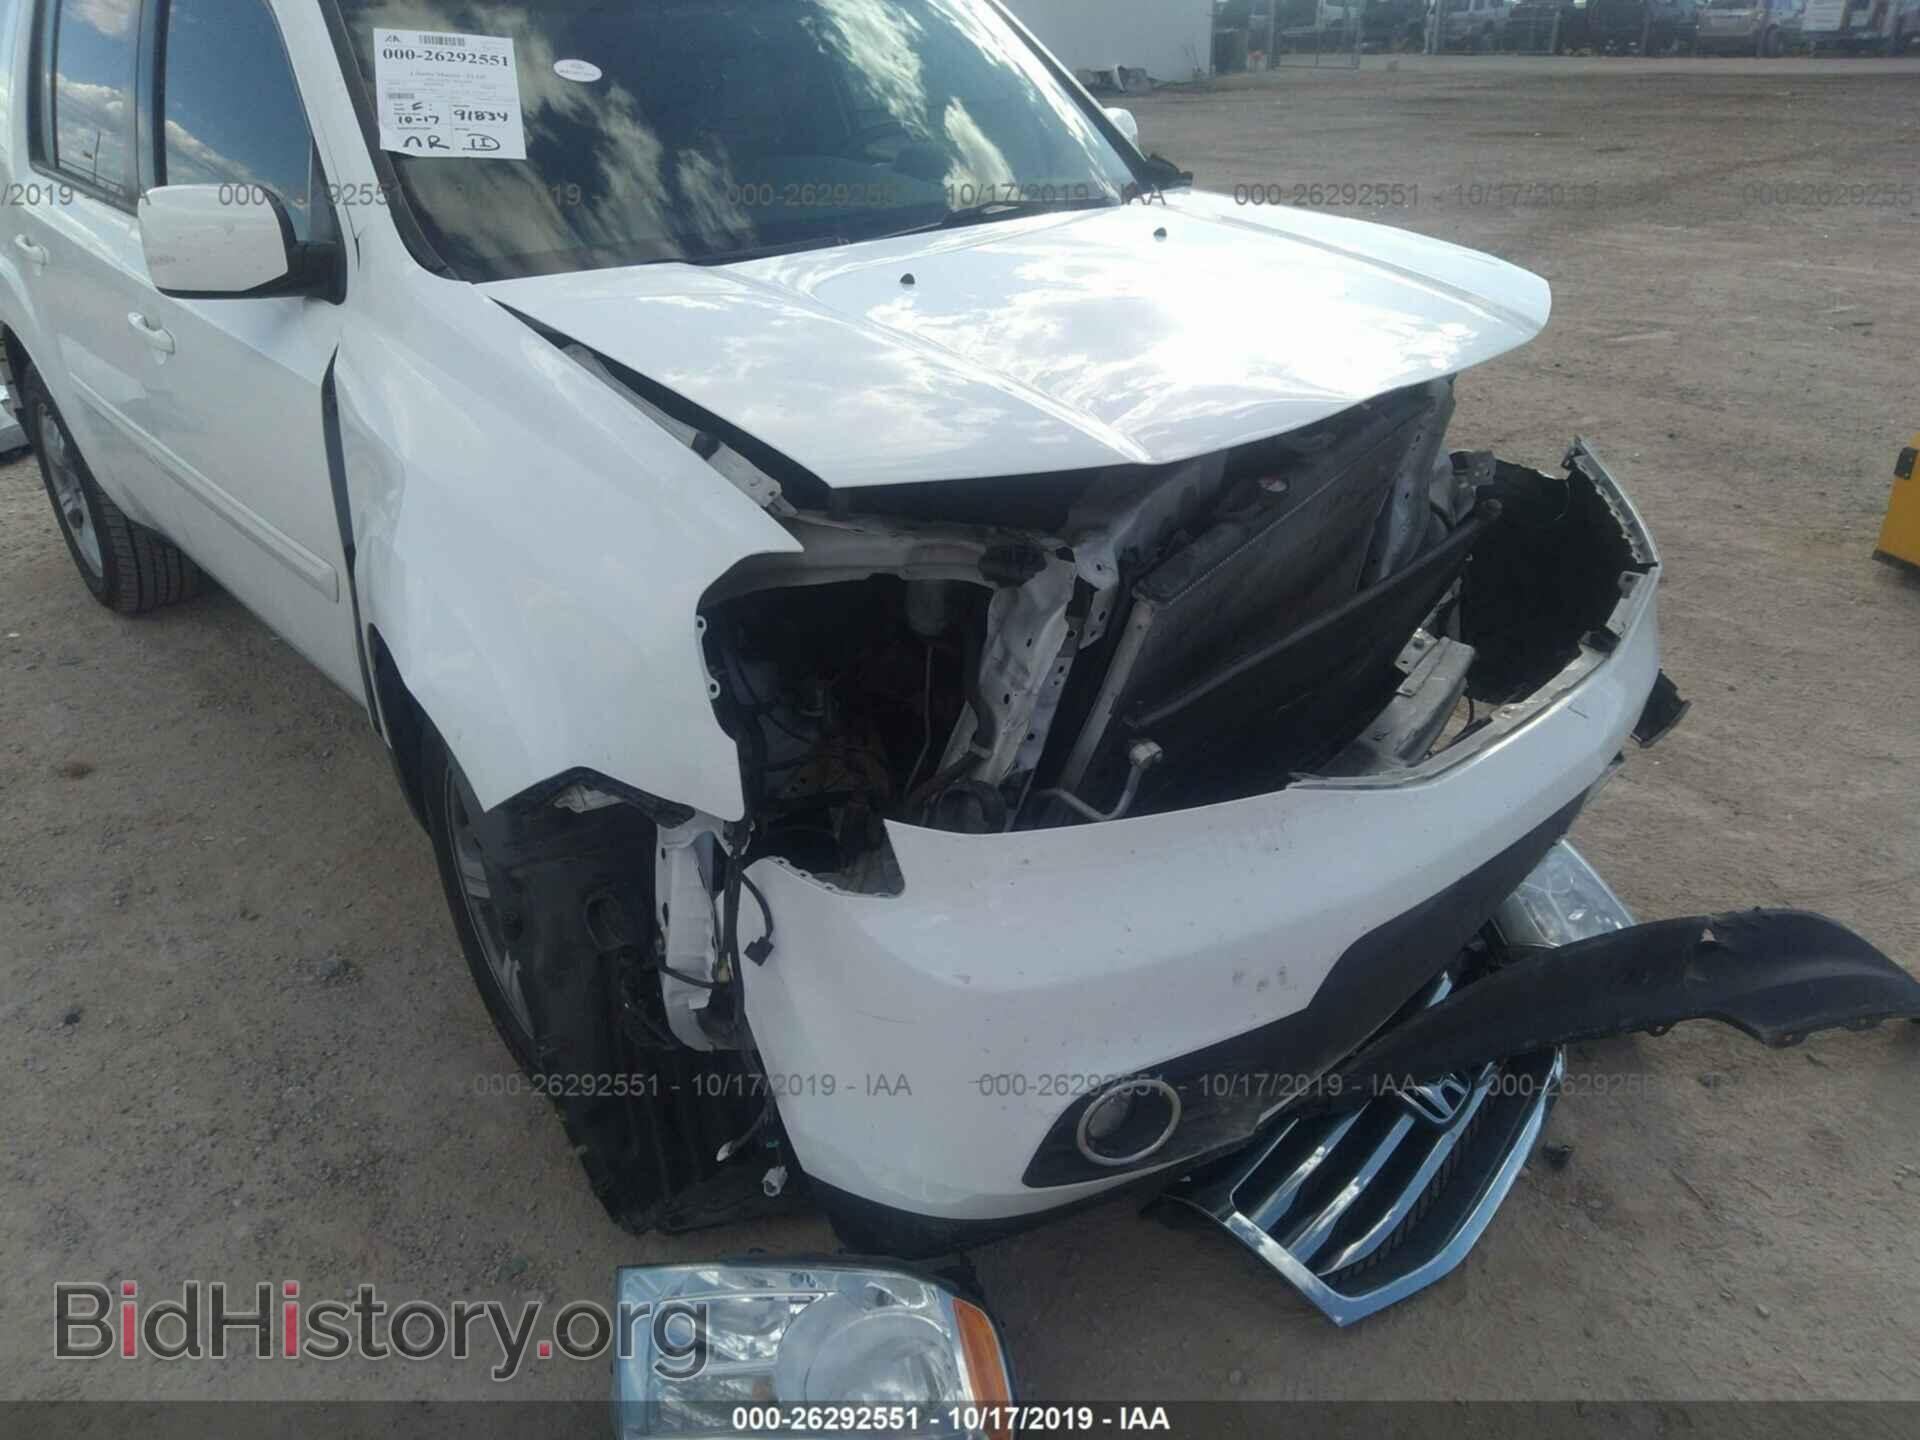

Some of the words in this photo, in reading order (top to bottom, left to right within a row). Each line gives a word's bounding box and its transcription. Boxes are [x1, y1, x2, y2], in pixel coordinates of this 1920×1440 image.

[382, 48, 509, 67] 000-26292551
[398, 115, 440, 124] 10-17
[453, 109, 508, 122] 91834
